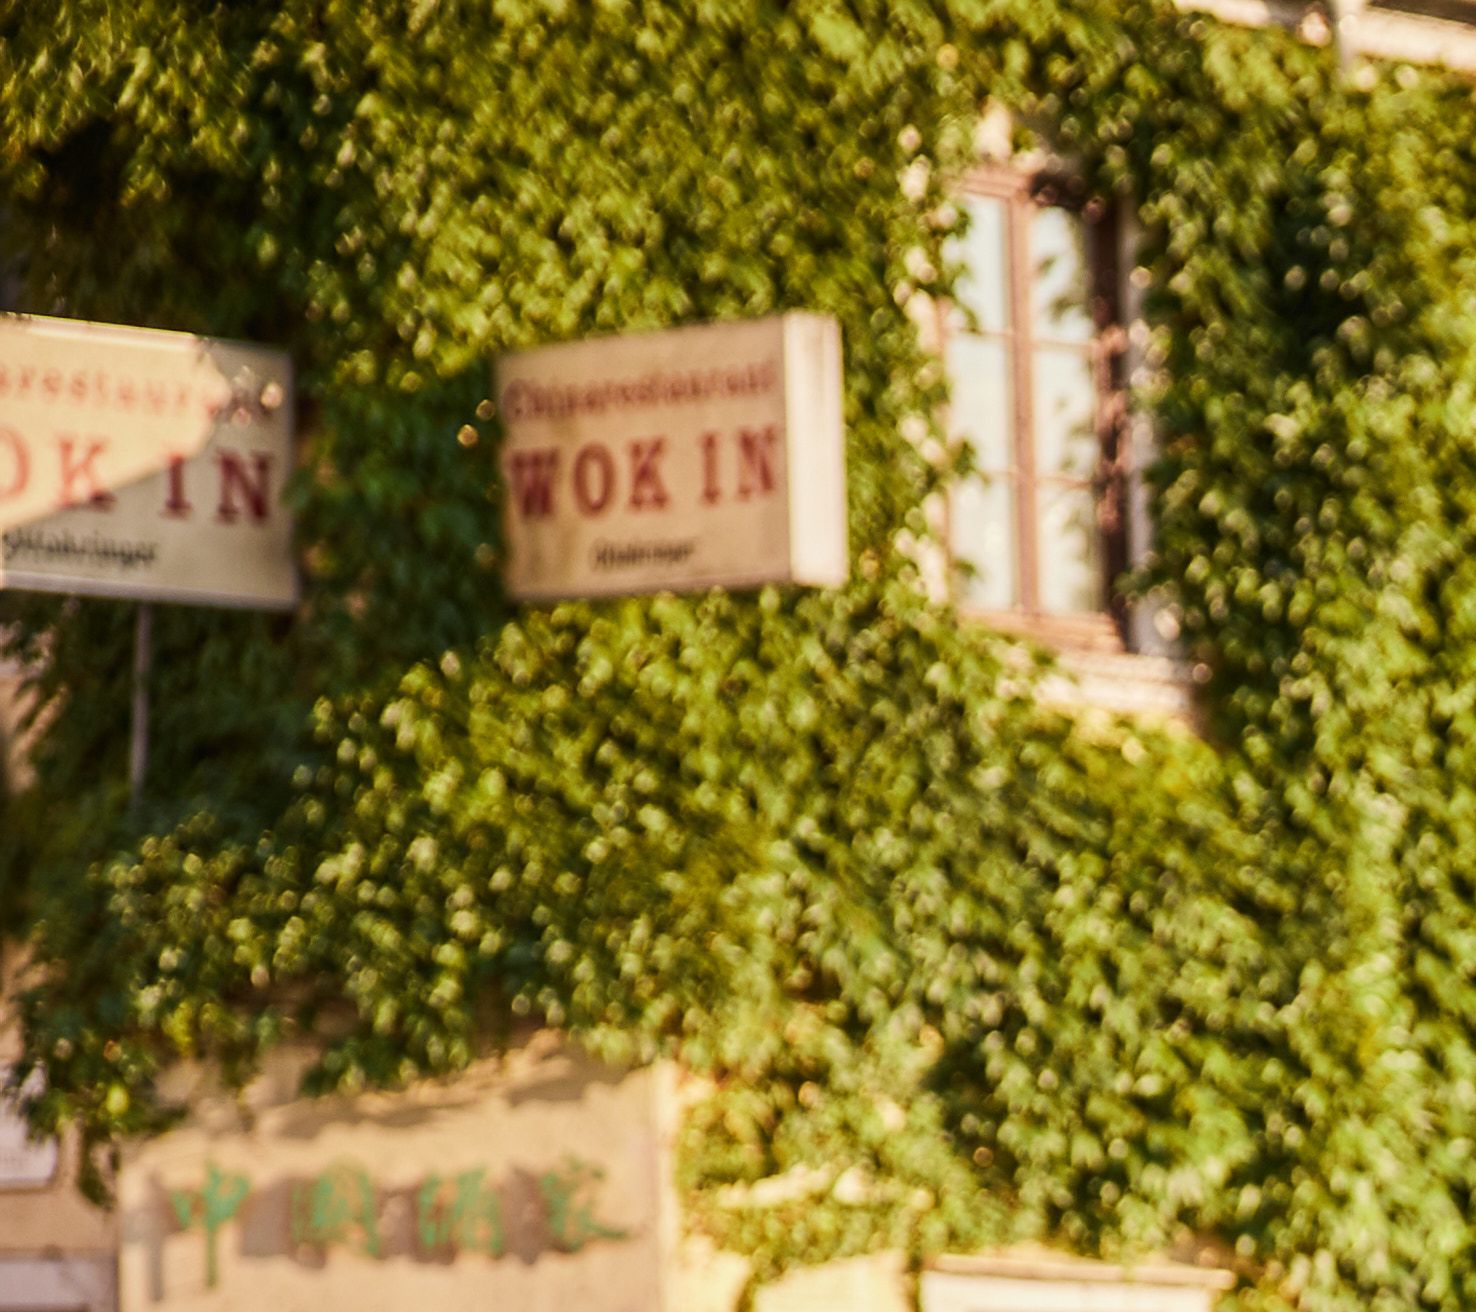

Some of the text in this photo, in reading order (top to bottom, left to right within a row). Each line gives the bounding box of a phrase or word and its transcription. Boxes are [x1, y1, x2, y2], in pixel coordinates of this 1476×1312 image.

[163, 450, 272, 524] IN
[508, 427, 775, 519] WOK IN
